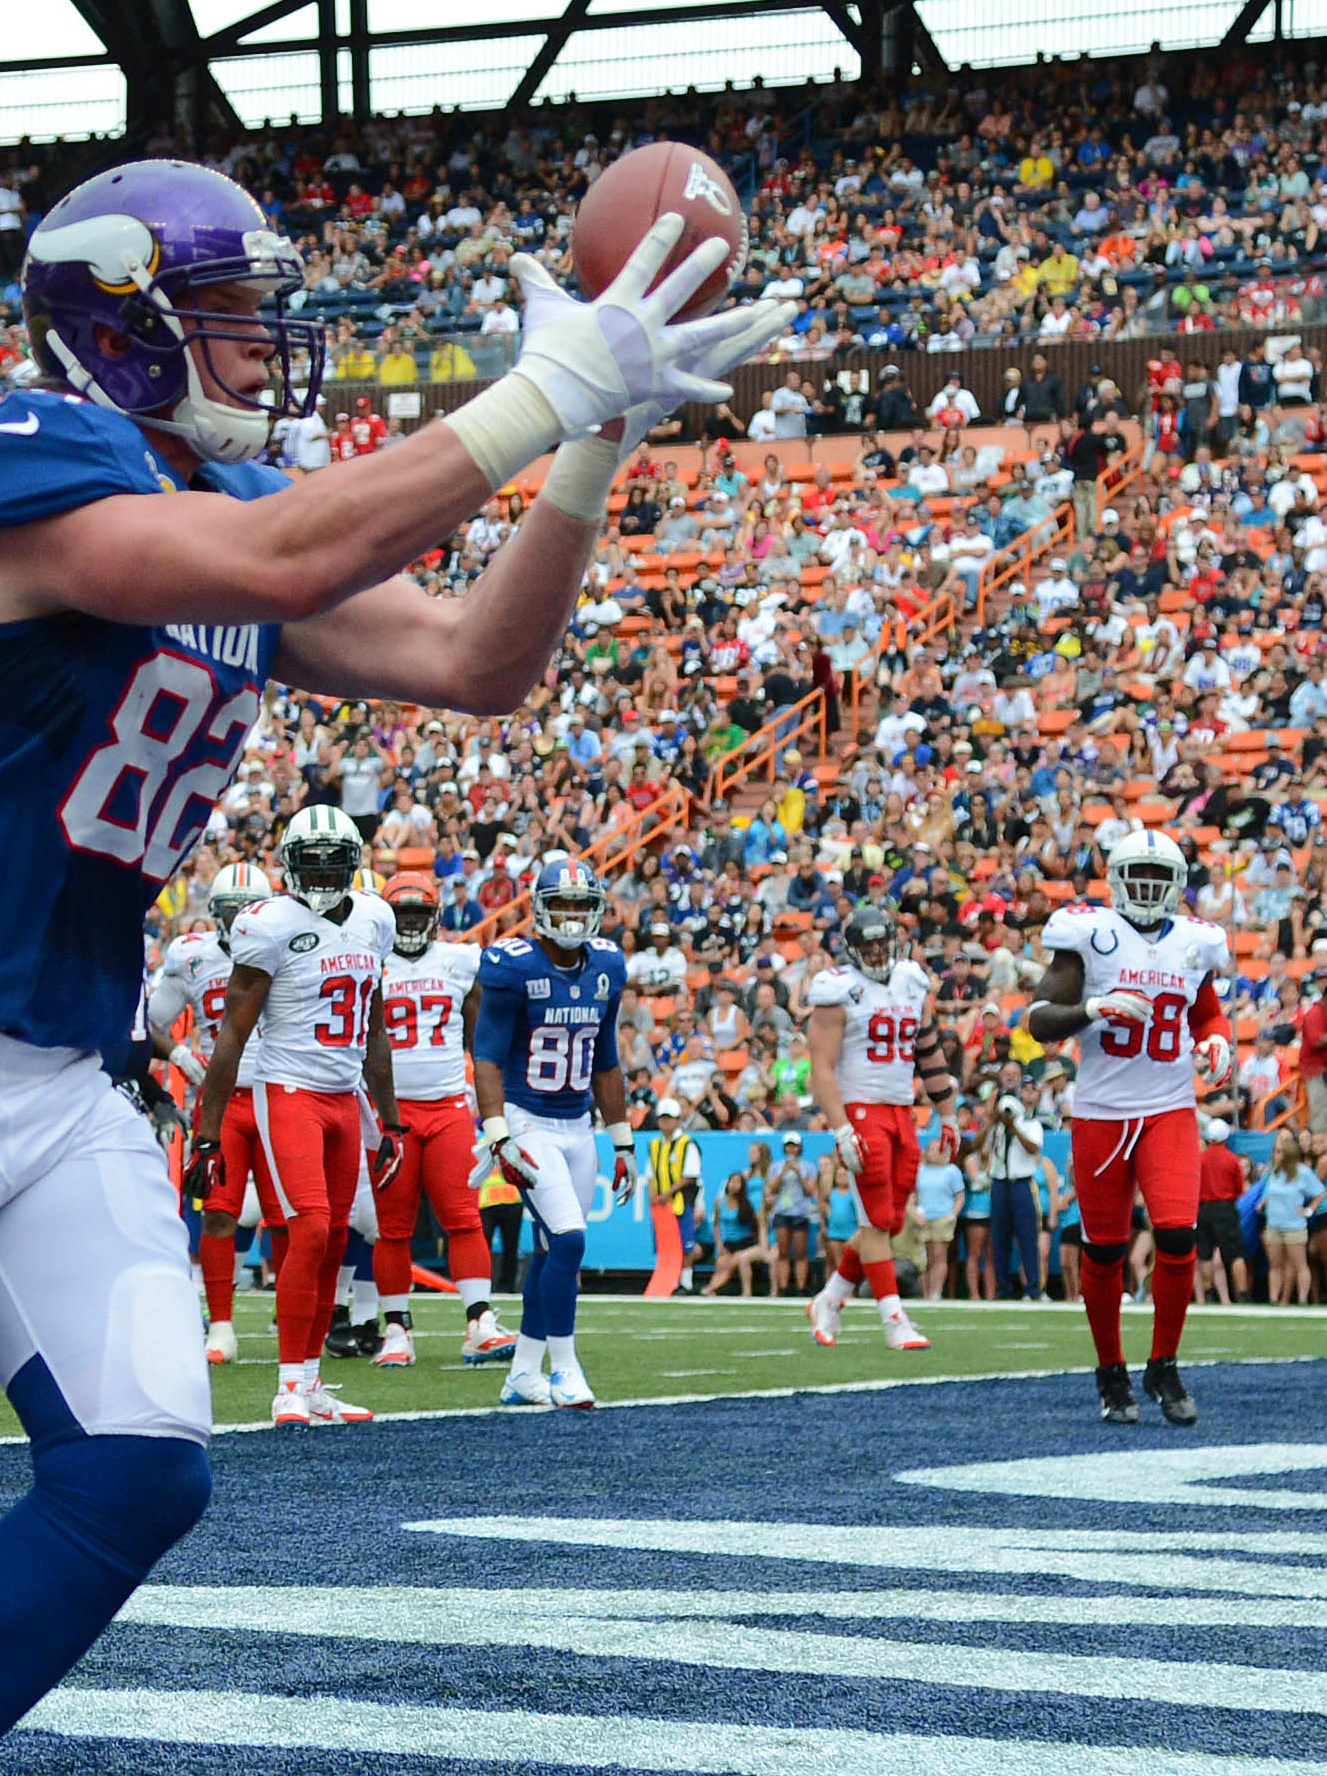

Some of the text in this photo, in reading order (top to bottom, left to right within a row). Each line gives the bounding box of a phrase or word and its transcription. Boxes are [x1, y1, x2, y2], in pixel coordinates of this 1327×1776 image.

[56, 646, 261, 884] 82
[320, 953, 375, 974] AMERICAN
[389, 978, 445, 994] AMERICAN
[1119, 968, 1185, 989] AMERICAN
[314, 975, 373, 1047] 31
[384, 995, 452, 1049] 97
[544, 1006, 600, 1024] NATIONAL
[526, 1025, 599, 1092] 80
[867, 1015, 917, 1063] 99
